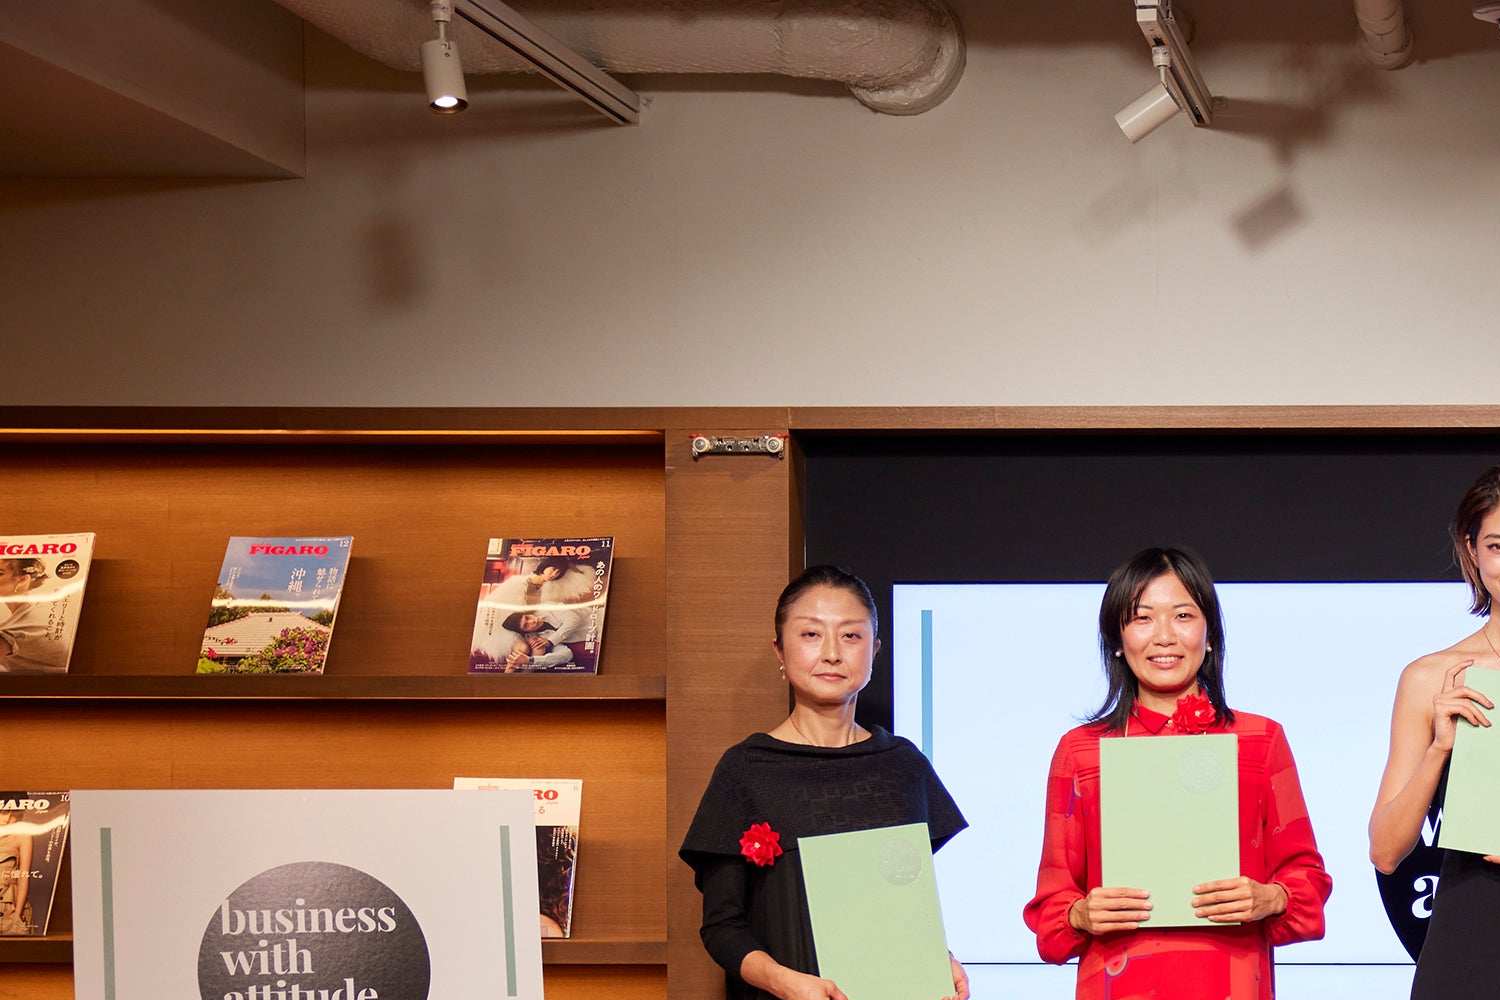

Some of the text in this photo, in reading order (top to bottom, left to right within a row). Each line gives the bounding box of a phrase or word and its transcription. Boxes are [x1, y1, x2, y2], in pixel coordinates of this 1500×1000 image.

[249, 545, 329, 555] FIGARO
[339, 540, 350, 548] 12
[509, 545, 591, 557] FIGARO
[585, 561, 606, 654] あの人のワドローブ計画。
[221, 898, 397, 936] business
[220, 938, 315, 976] with
